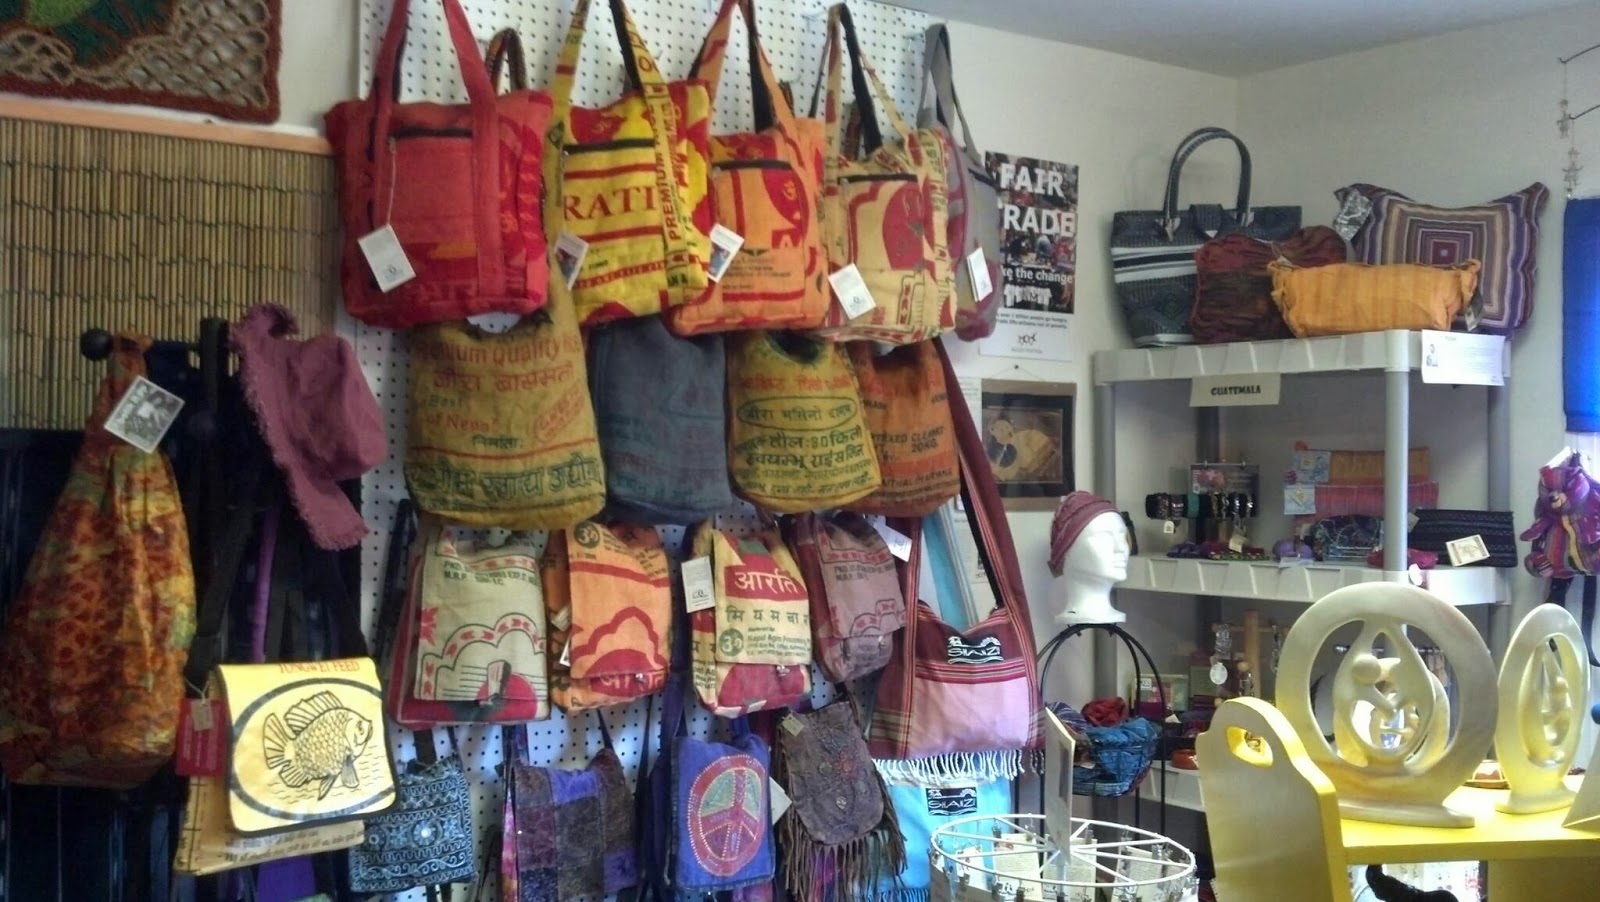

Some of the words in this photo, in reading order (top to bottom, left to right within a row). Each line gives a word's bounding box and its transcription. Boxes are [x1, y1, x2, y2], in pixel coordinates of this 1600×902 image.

[655, 152, 682, 241] PREMIUM
[1001, 163, 1065, 199] FAIR
[998, 198, 1076, 238] RADE
[1016, 266, 1034, 280] the
[1035, 270, 1073, 285] change
[493, 336, 560, 367] Quality
[1210, 385, 1262, 396] GUATEMALA
[333, 660, 360, 672] FEED
